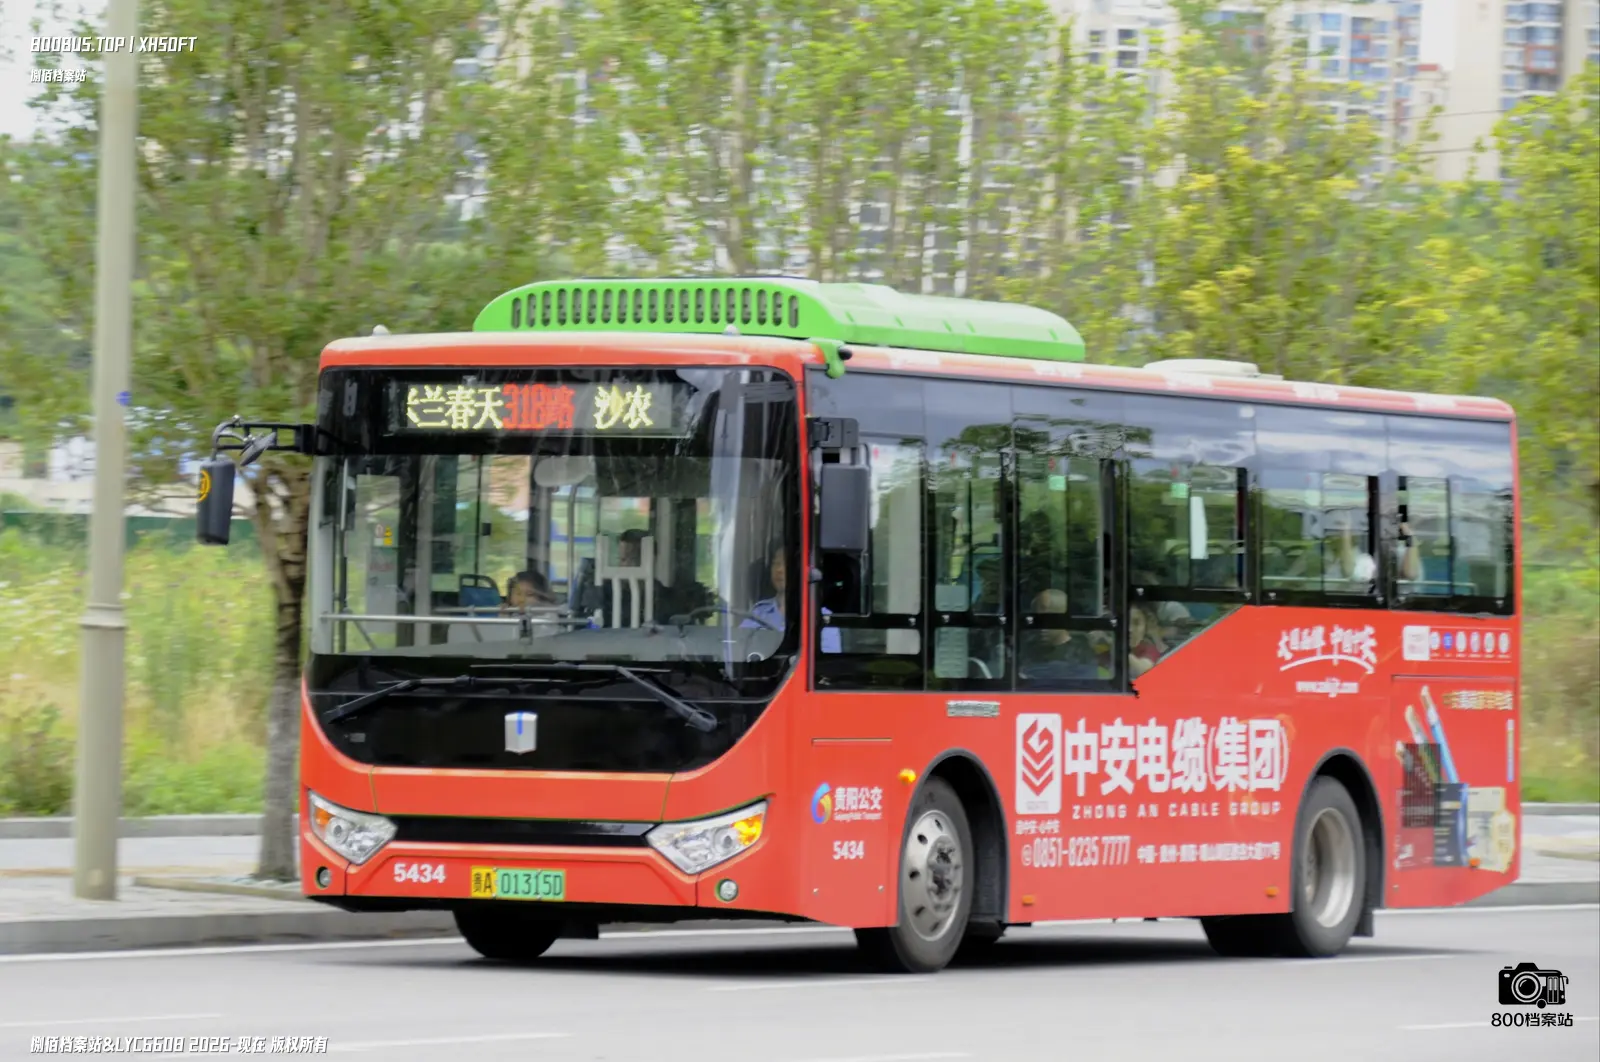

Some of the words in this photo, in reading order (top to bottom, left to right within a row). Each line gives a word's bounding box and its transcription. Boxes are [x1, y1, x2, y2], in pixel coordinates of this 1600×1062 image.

[1064, 717, 1288, 797] 中安电缆(集团)
[1072, 805, 1127, 819] ZHONG
[1137, 803, 1159, 817] AN
[1168, 802, 1220, 817] CABLE
[1229, 801, 1281, 816] GROUP
[833, 840, 865, 860] 5434
[394, 863, 446, 883] 5434
